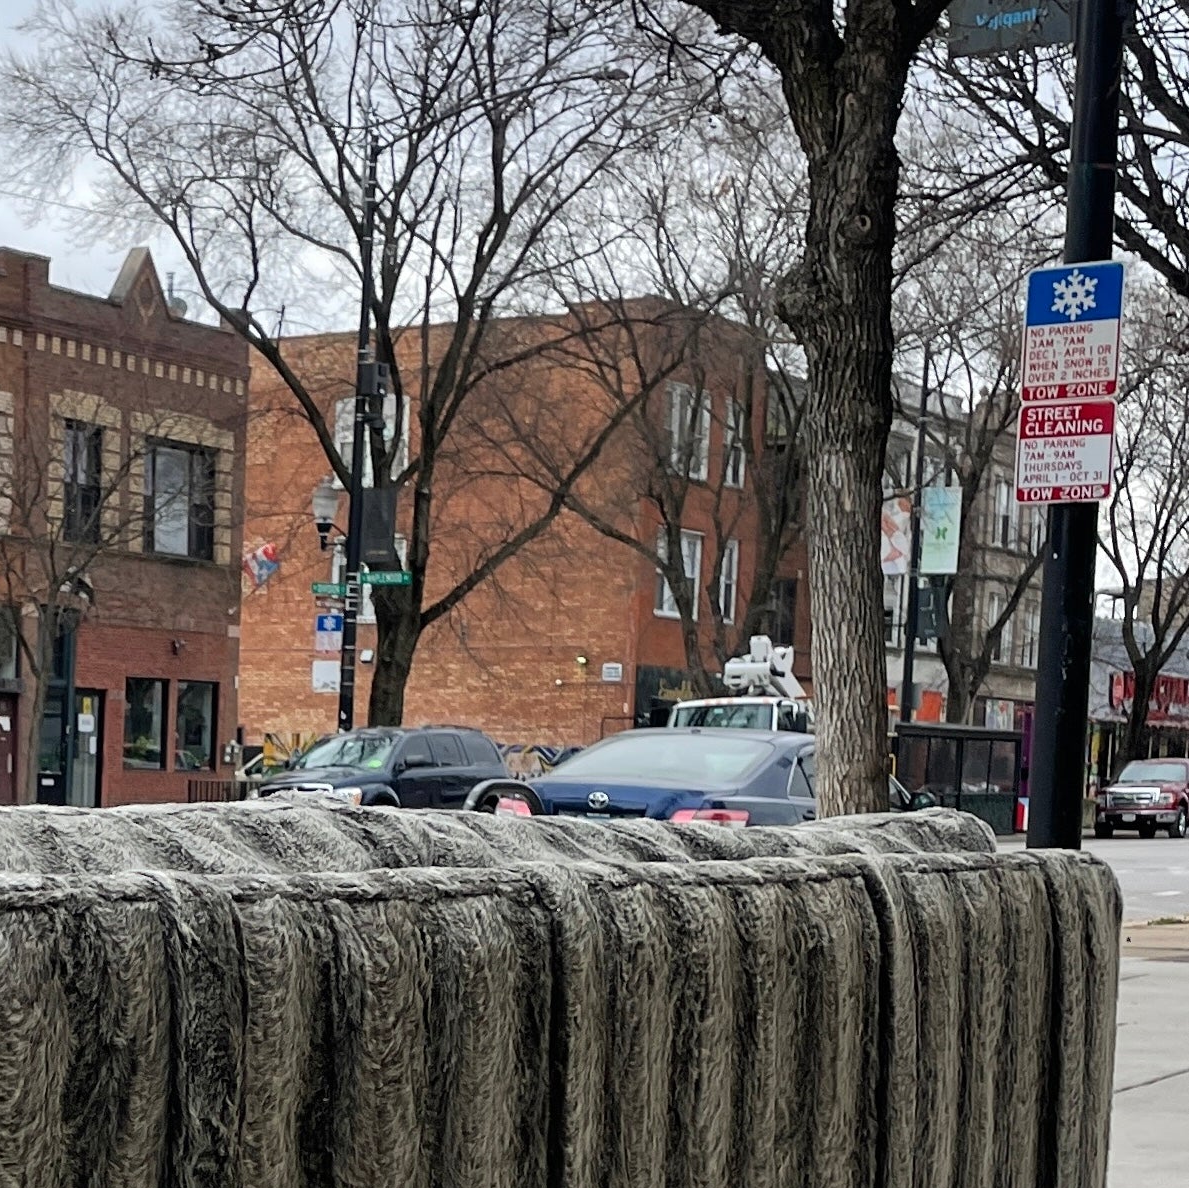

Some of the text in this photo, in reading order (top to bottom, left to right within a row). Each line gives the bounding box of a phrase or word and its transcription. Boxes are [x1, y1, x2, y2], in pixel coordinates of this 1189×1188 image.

[1030, 324, 1094, 338] NO PARKING
[1030, 338, 1054, 349] 3AM
[1063, 336, 1085, 347] 7AM
[1029, 350, 1048, 360] DEC
[1064, 347, 1085, 357] APR
[1097, 344, 1112, 355] OR
[1029, 357, 1108, 371] WHEN SNOW IS
[1028, 368, 1110, 383] OVER 2 INCHES
[1027, 381, 1108, 400] TOW ZONE
[1026, 405, 1083, 422] STREET
[1025, 418, 1104, 436] CLEANING
[1024, 438, 1086, 450] NO PARKING
[1024, 451, 1045, 461] 7AM
[1053, 450, 1075, 460] 9AM
[1023, 460, 1083, 472] THURSDAYS
[1022, 473, 1051, 484] APRIL
[1069, 471, 1089, 482] OCT
[1092, 470, 1103, 480] 31
[1021, 486, 1105, 501] TOW ZON
